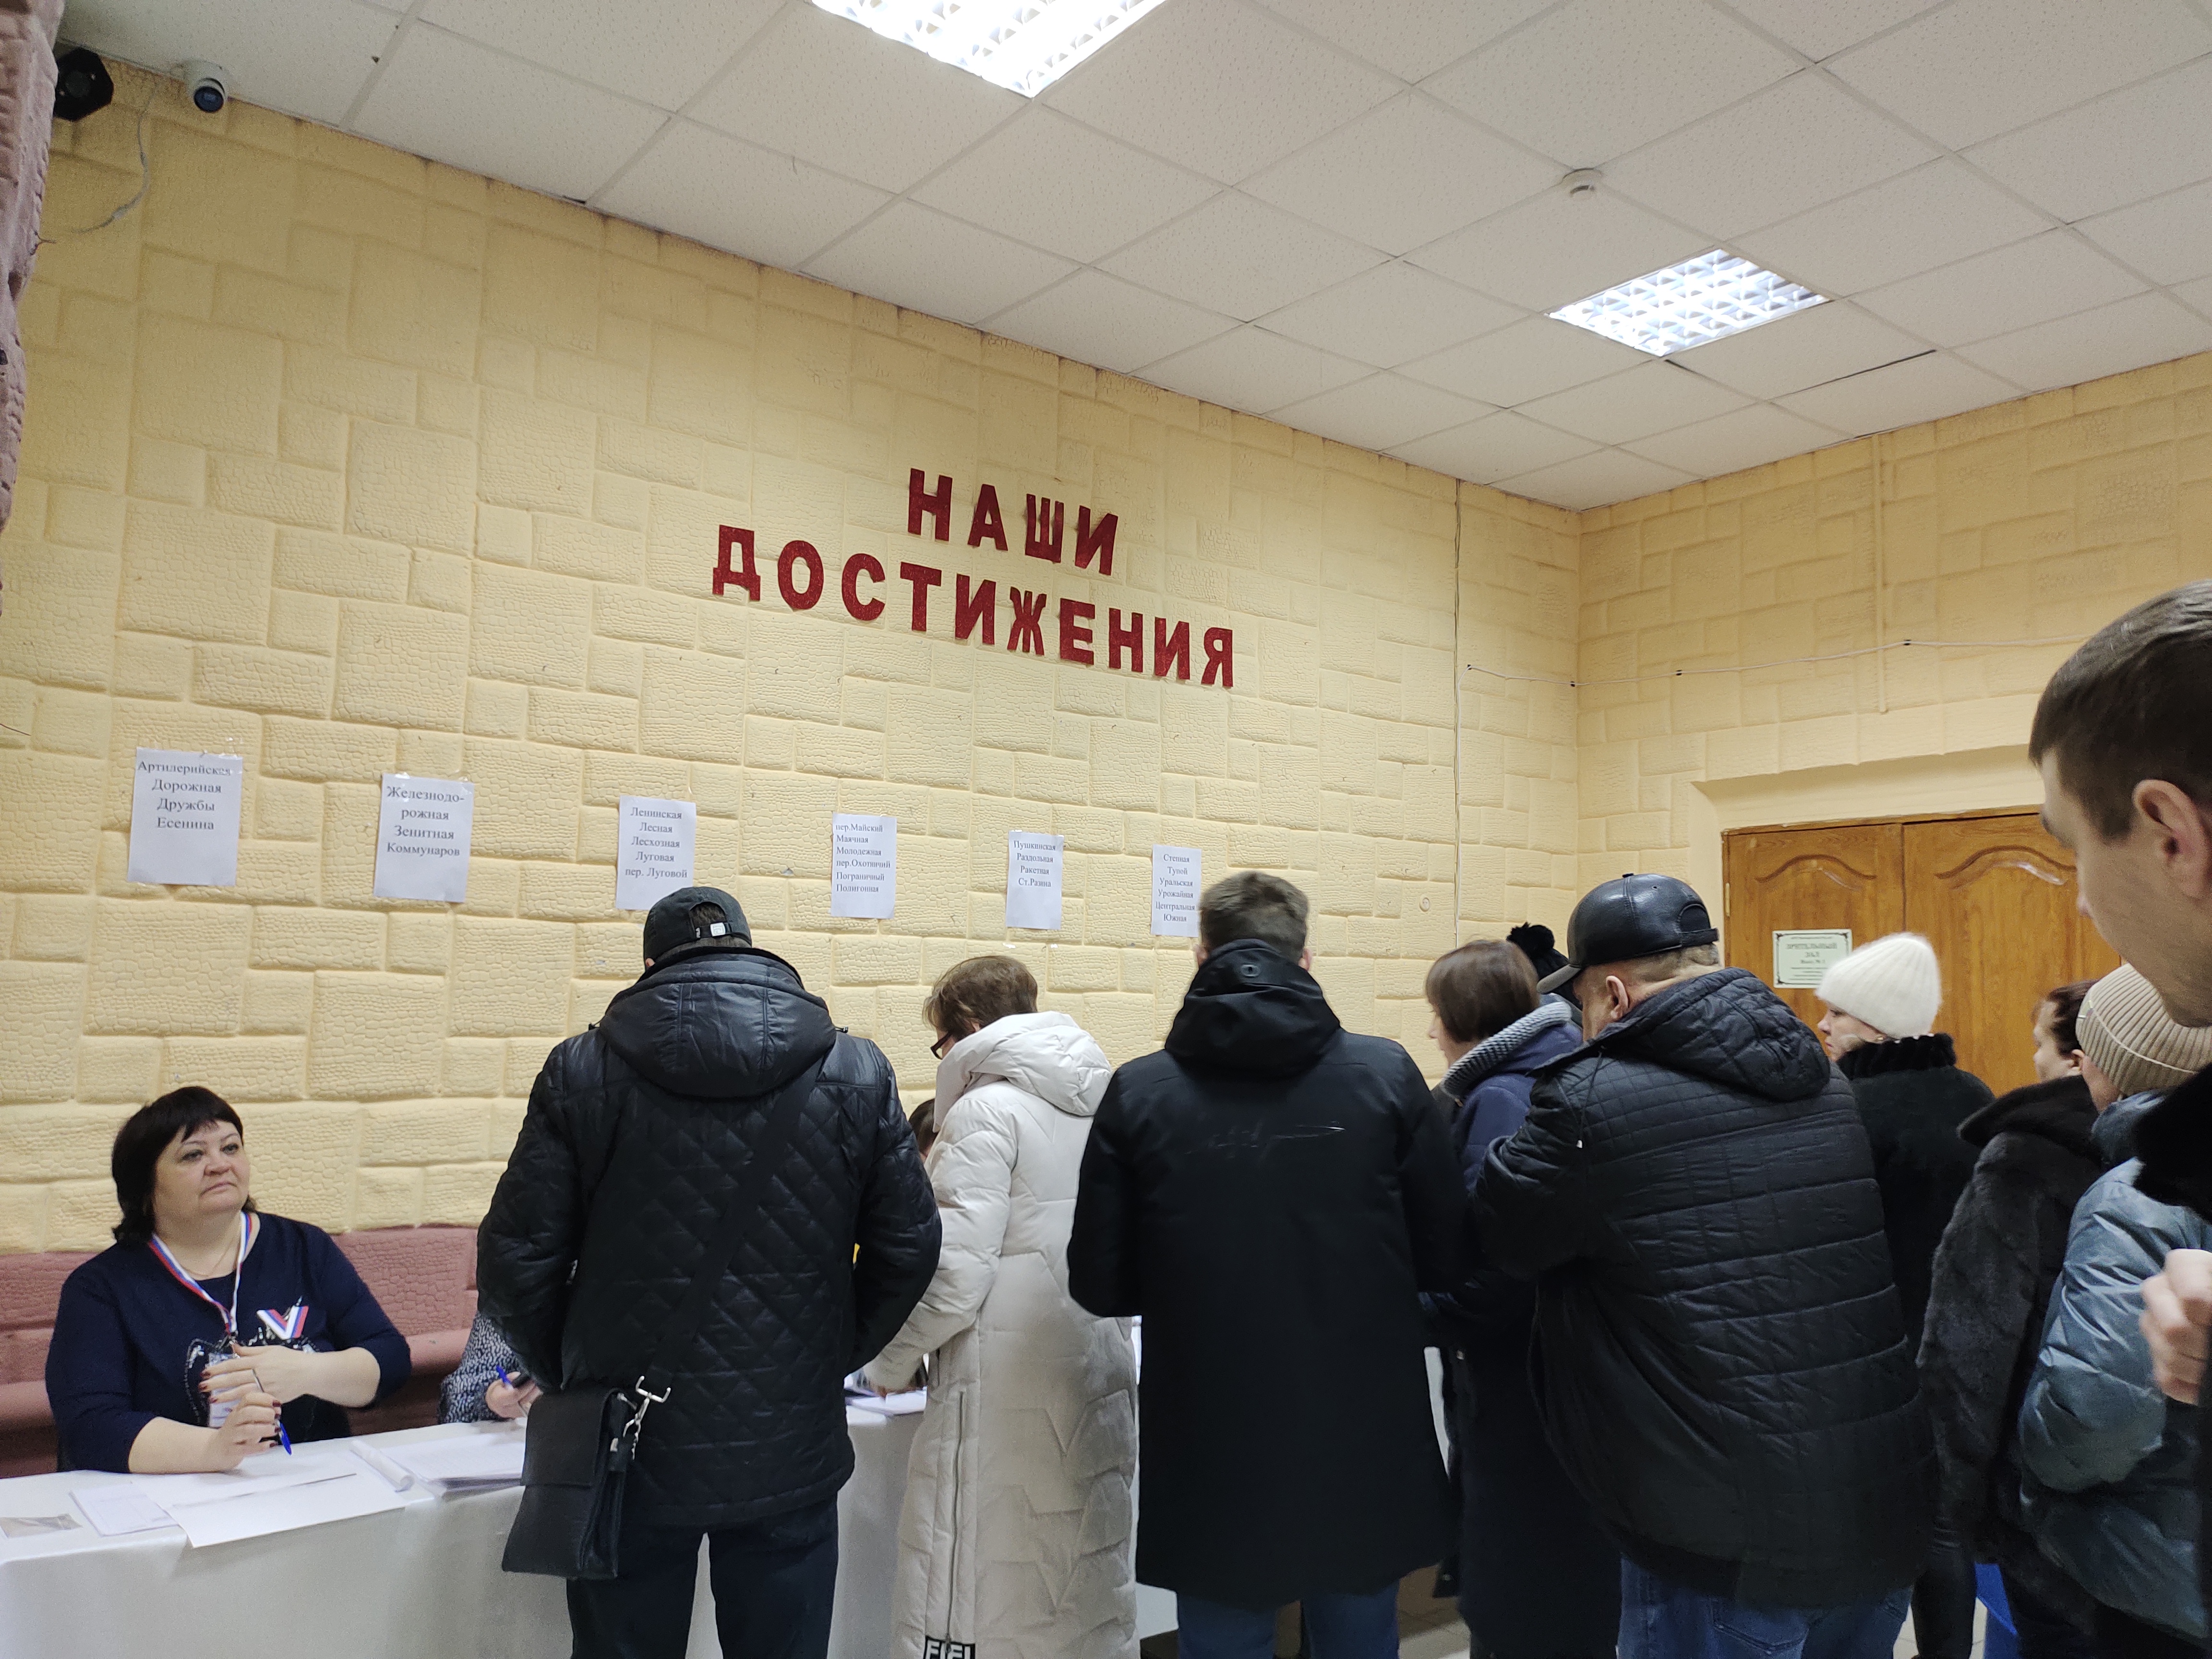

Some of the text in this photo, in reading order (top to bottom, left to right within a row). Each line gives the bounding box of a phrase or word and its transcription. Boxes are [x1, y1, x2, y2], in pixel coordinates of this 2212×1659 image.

[907, 468, 1118, 576] НАШИ
[712, 525, 1234, 688] ДОСТИЖЕНИЯ
[152, 779, 221, 793] Дорожная
[387, 786, 465, 803] Железнодо-
[156, 798, 215, 813] Дружбы
[401, 809, 449, 820] рожная
[630, 807, 682, 819] Ленинская
[157, 817, 214, 830] Есенина
[639, 822, 673, 833] Лесная
[394, 825, 454, 840] Зенитная
[631, 836, 680, 848] Лесхозная
[837, 834, 868, 843] Маячная
[387, 842, 460, 858] Коммунаров
[836, 846, 881, 856] Молодежная
[1014, 840, 1056, 851] Пушкинская
[635, 851, 674, 863] Луговая
[1017, 853, 1053, 863] Раздольная
[1163, 854, 1190, 863] Степная
[625, 867, 687, 879] пер. Луговой
[1021, 865, 1049, 875] Ракетная
[1167, 866, 1188, 876] Тупой
[837, 872, 885, 882] Пограничный
[1159, 877, 1193, 887] Уральская
[836, 884, 879, 892] Полигонная
[1158, 889, 1193, 899] Урожайная
[1155, 901, 1195, 912] Центральная
[1164, 914, 1187, 922] Южная
